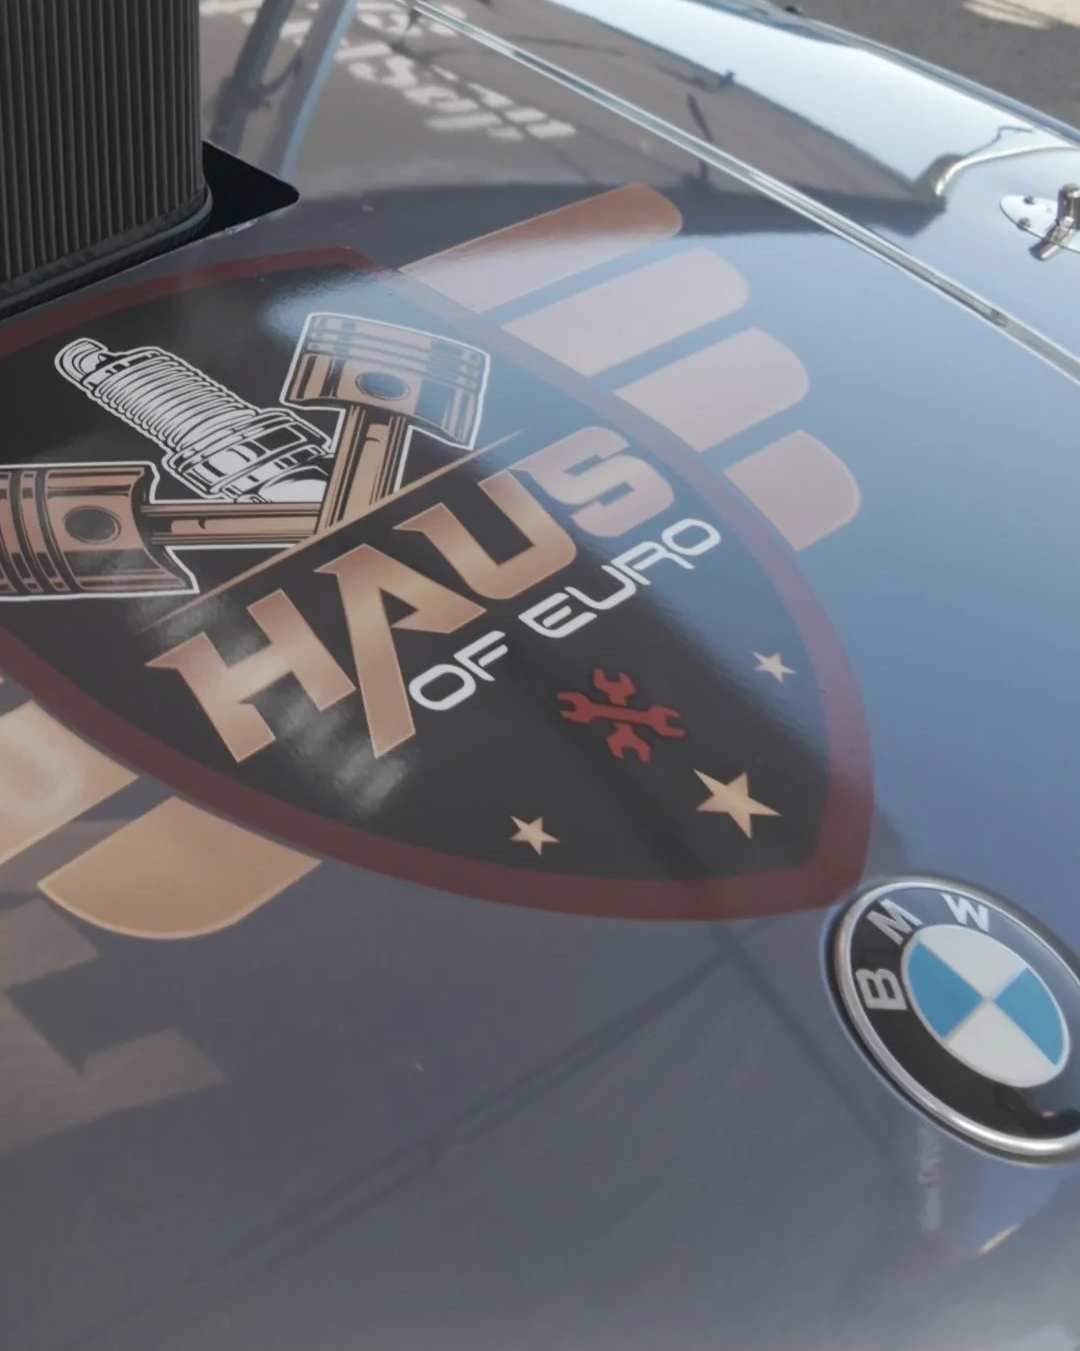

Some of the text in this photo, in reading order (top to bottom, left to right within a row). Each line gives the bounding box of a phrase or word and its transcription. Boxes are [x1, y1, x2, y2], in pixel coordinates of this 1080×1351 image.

[145, 426, 675, 764] HAUS
[409, 518, 722, 712] OF EURO
[855, 893, 990, 1011] BMW
